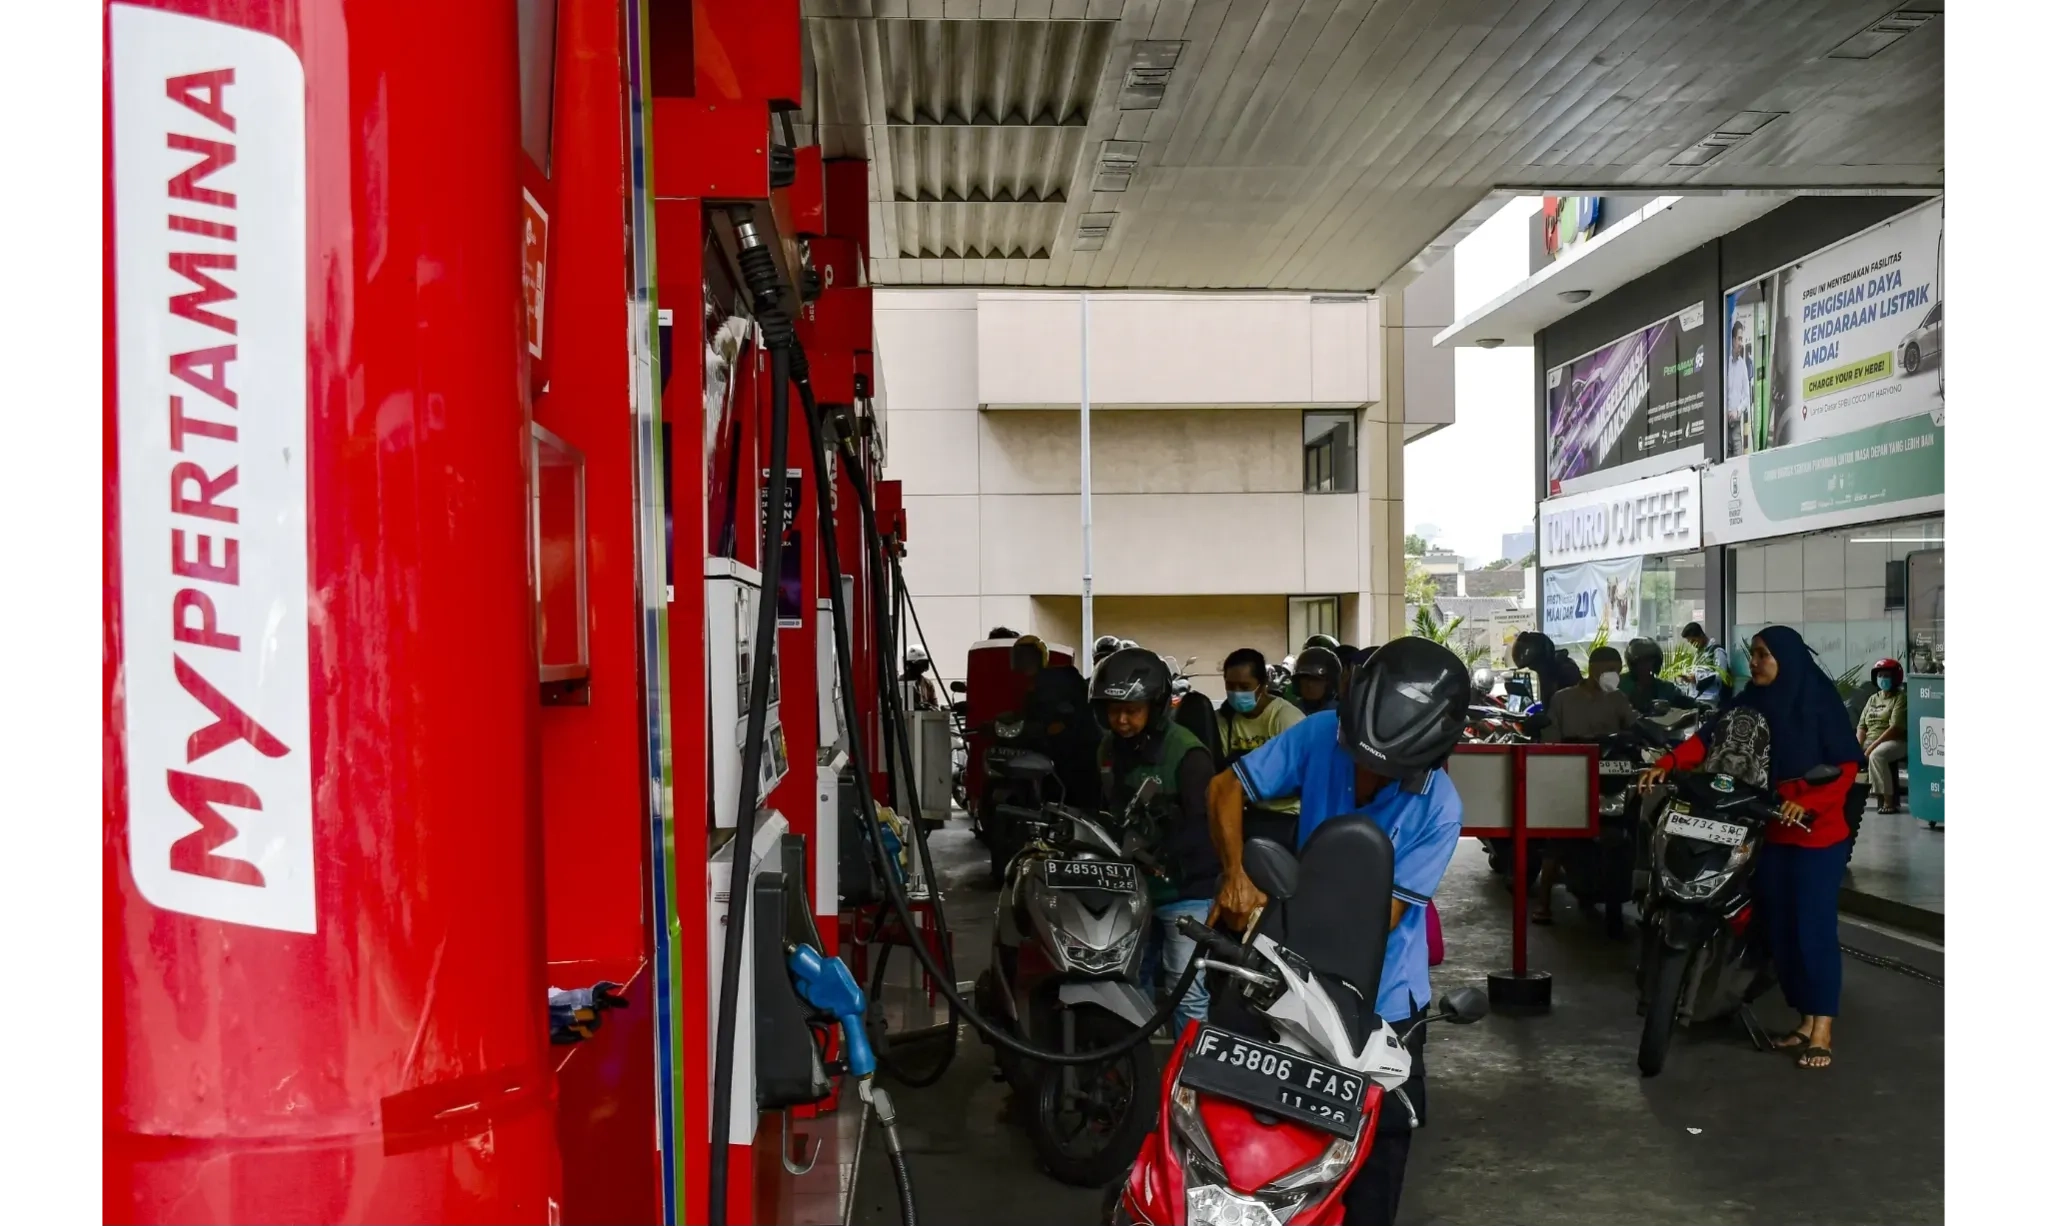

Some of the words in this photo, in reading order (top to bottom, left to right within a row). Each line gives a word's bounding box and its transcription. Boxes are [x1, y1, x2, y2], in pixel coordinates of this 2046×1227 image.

[1802, 286, 1817, 300] SPBU
[1818, 283, 1826, 293] INI
[1827, 264, 1870, 290] MENYEDIAKAN
[1870, 251, 1902, 272] FASILITAS
[1803, 283, 1864, 323] PENGISIAN
[1867, 269, 1902, 299] DAYA
[1803, 303, 1877, 346] KENDARAAN
[1880, 283, 1930, 319] LISTRIK
[1803, 341, 1839, 368] ANDA!
[1808, 376, 1834, 392] CHARGE
[1835, 371, 1853, 383] YOUR
[1854, 368, 1863, 379] EV
[1864, 361, 1885, 376] HERE!
[1875, 384, 1902, 398] HARYONO
[1870, 443, 1888, 458] DEPAN
[1889, 440, 1904, 455] YANG
[1904, 436, 1920, 451] LEBIH
[1921, 433, 1935, 448] BAIK
[1543, 502, 1609, 554] TOMORO
[1612, 486, 1689, 545] COFFEE
[1920, 687, 1931, 699] BSI
[1359, 741, 1387, 760] HONDA
[1671, 814, 1679, 823] B
[1048, 862, 1057, 873] B
[1064, 863, 1098, 875] 4853
[1201, 1035, 1219, 1056] F
[1230, 1043, 1293, 1081] 5806
[1306, 1068, 1357, 1102] FAS
